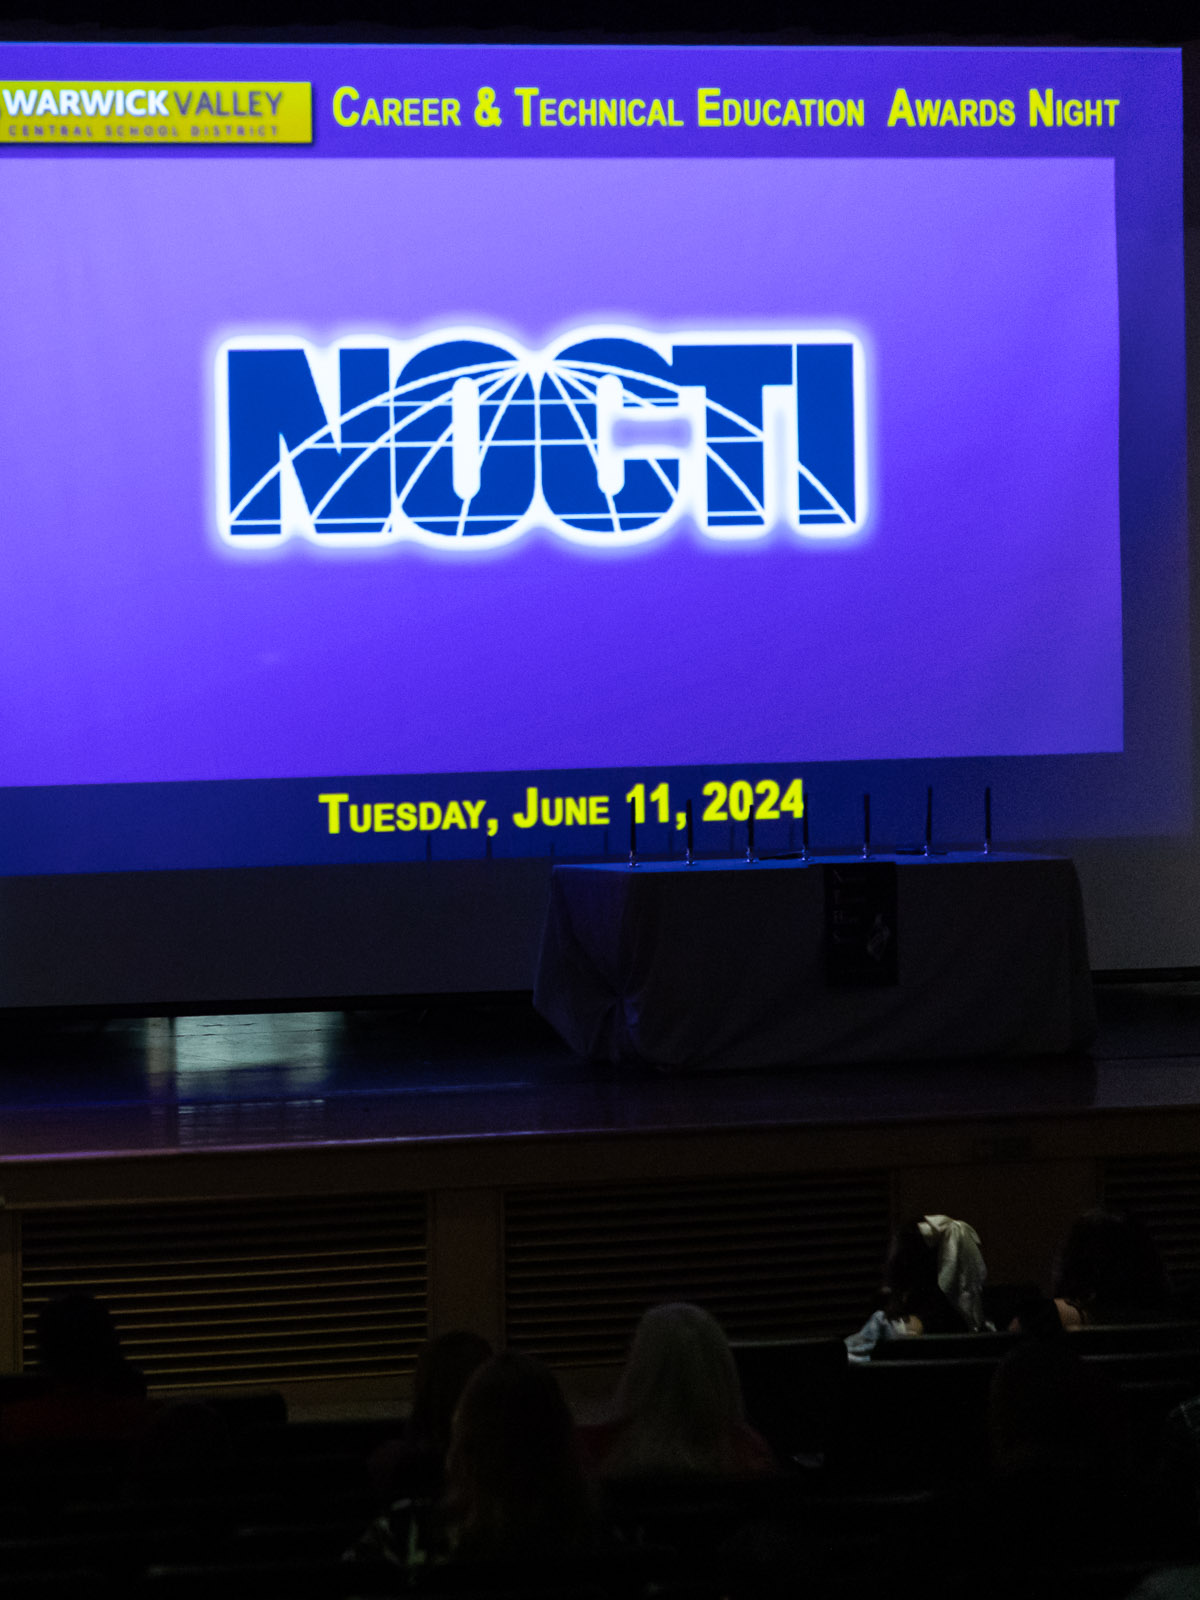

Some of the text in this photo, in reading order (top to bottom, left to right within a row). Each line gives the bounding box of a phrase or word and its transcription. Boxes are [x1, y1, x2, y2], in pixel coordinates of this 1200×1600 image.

[2, 88, 169, 117] WARWICK
[173, 91, 283, 116] VALLEY
[474, 86, 502, 127] &
[8, 125, 278, 137] CENTRAL SCHOOL DISTRICT
[227, 337, 856, 537] NOCTI
[625, 782, 687, 831] 11,
[702, 778, 804, 821] 2024
